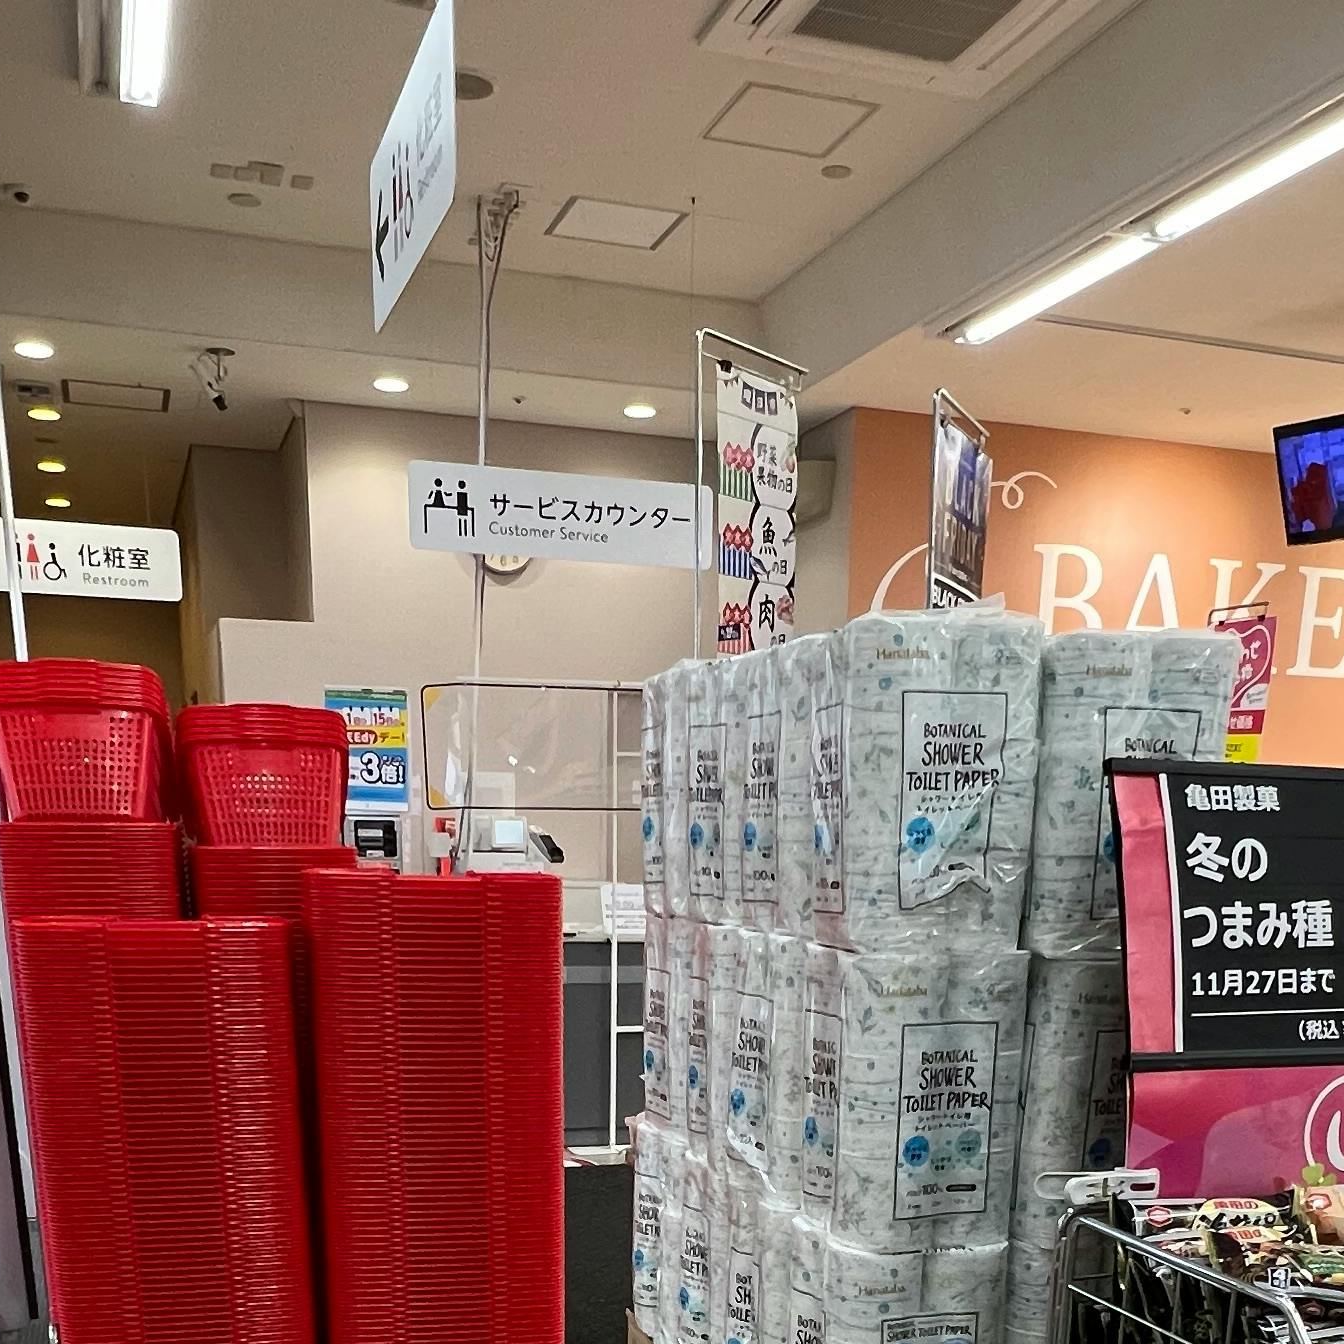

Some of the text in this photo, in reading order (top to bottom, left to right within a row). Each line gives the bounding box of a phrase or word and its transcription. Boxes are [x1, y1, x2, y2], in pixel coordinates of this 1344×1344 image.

[489, 493, 691, 529] サービスカウンター
[488, 521, 609, 544] Customer Service
[78, 543, 151, 571] 化粧室
[82, 573, 149, 588] Restroom
[758, 594, 775, 632] 肉
[923, 722, 987, 740] BOTANICAL
[920, 741, 985, 767] SHOWER
[905, 769, 1000, 793] TOILET PAPER
[1184, 783, 1281, 812] 亀田製菓
[1185, 831, 1268, 883] 冬の
[1183, 899, 1336, 950] つまみ種
[1191, 967, 1336, 997] 11月27日まで
[921, 1049, 979, 1065] BOTANICAL
[918, 1065, 977, 1091] SHOWER
[902, 1090, 991, 1114] TOILET PAPER
